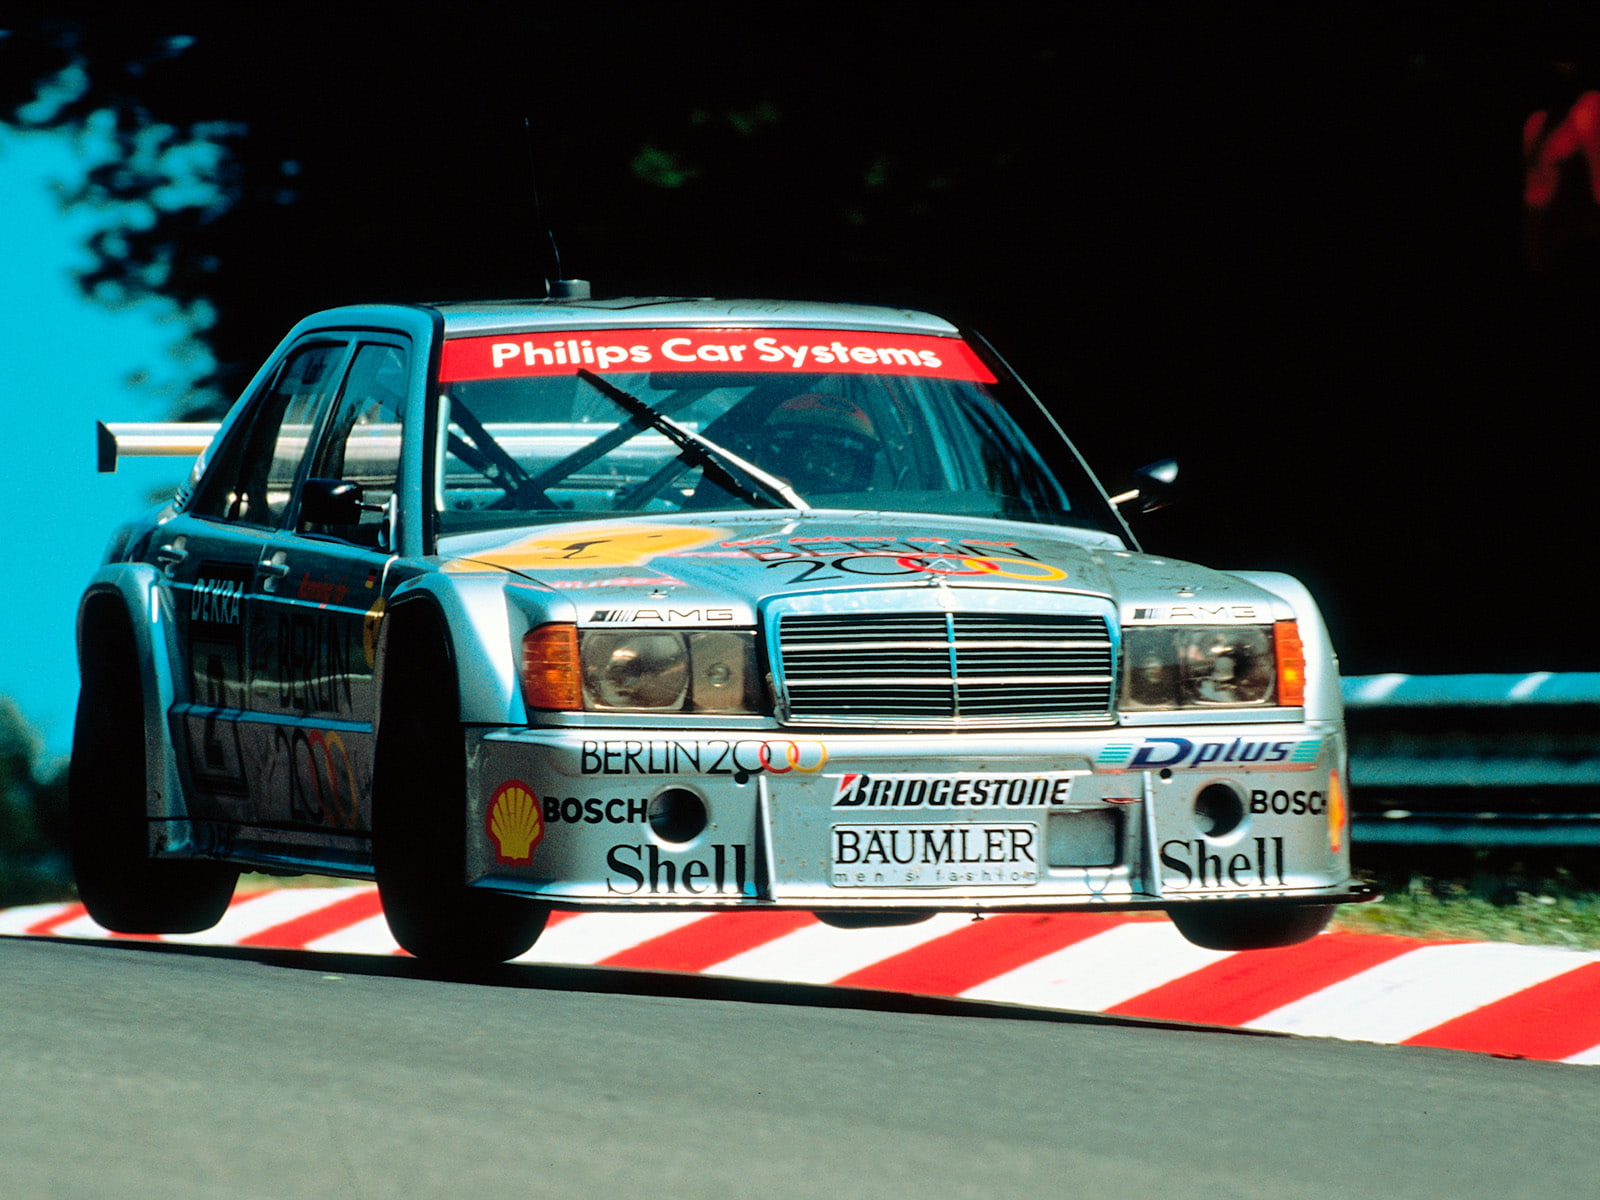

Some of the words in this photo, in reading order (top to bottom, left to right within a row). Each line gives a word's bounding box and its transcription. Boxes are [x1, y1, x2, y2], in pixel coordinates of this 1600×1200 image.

[492, 338, 652, 370] Philips
[661, 338, 746, 363] Car
[754, 337, 942, 369] Systems
[766, 553, 1067, 585] 2000
[191, 577, 245, 625] DEKRA
[631, 609, 733, 622] AMG
[580, 740, 702, 775] BERLIN
[705, 739, 829, 775] 2000
[832, 773, 1071, 807] BRIDGESTONE
[542, 797, 648, 824] BOSCH
[834, 828, 1035, 865] BÄUMLER
[1160, 836, 1288, 890] Shell
[606, 844, 750, 895] Shell
